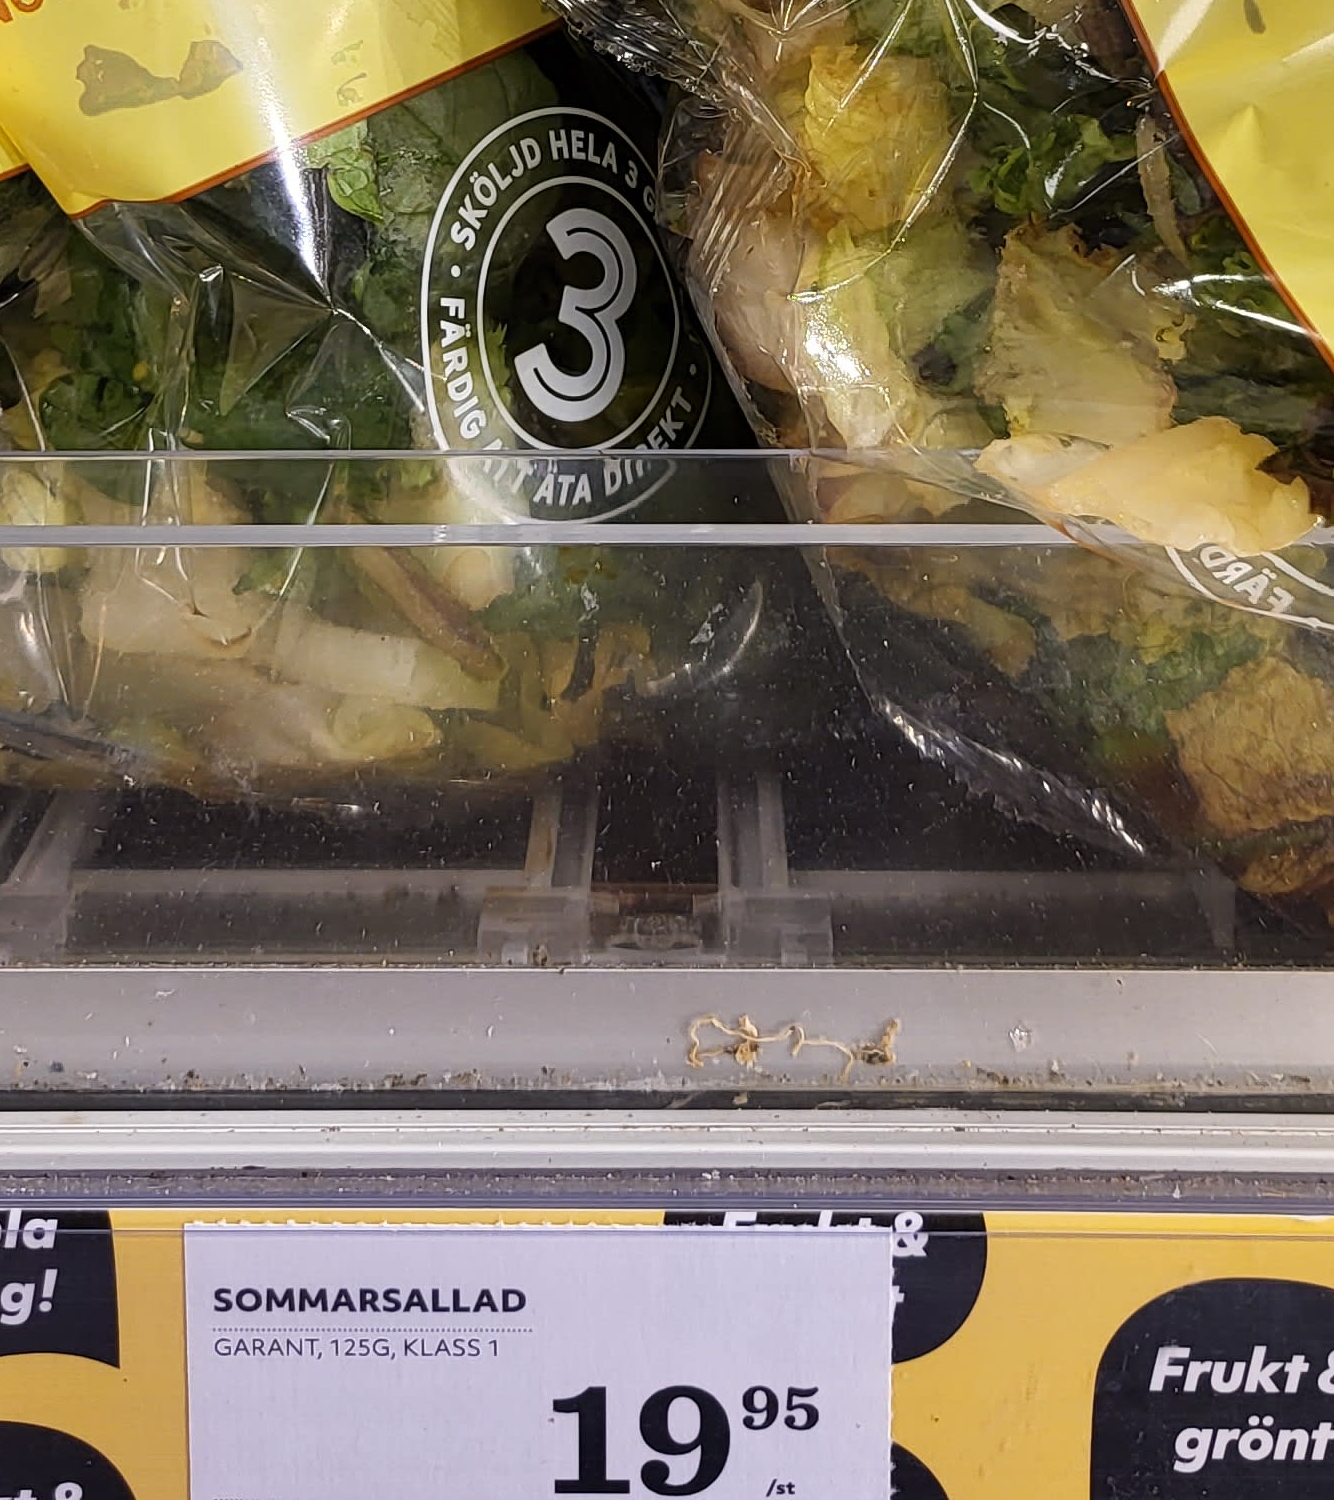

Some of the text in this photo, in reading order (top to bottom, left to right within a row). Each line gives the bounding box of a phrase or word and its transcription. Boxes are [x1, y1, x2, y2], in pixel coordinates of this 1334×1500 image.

[450, 136, 542, 252] SKÖLJD
[548, 128, 618, 174] HELA
[514, 207, 639, 422] 3
[439, 296, 487, 442] FÄRDIG
[213, 1288, 527, 1314] SOMMARSALLAD
[213, 1337, 499, 1360] GARANT, 125G, KLASS 1
[1148, 1347, 1309, 1395] Frukt
[552, 1385, 820, 1498] 19 95
[766, 1478, 796, 1498] /st
